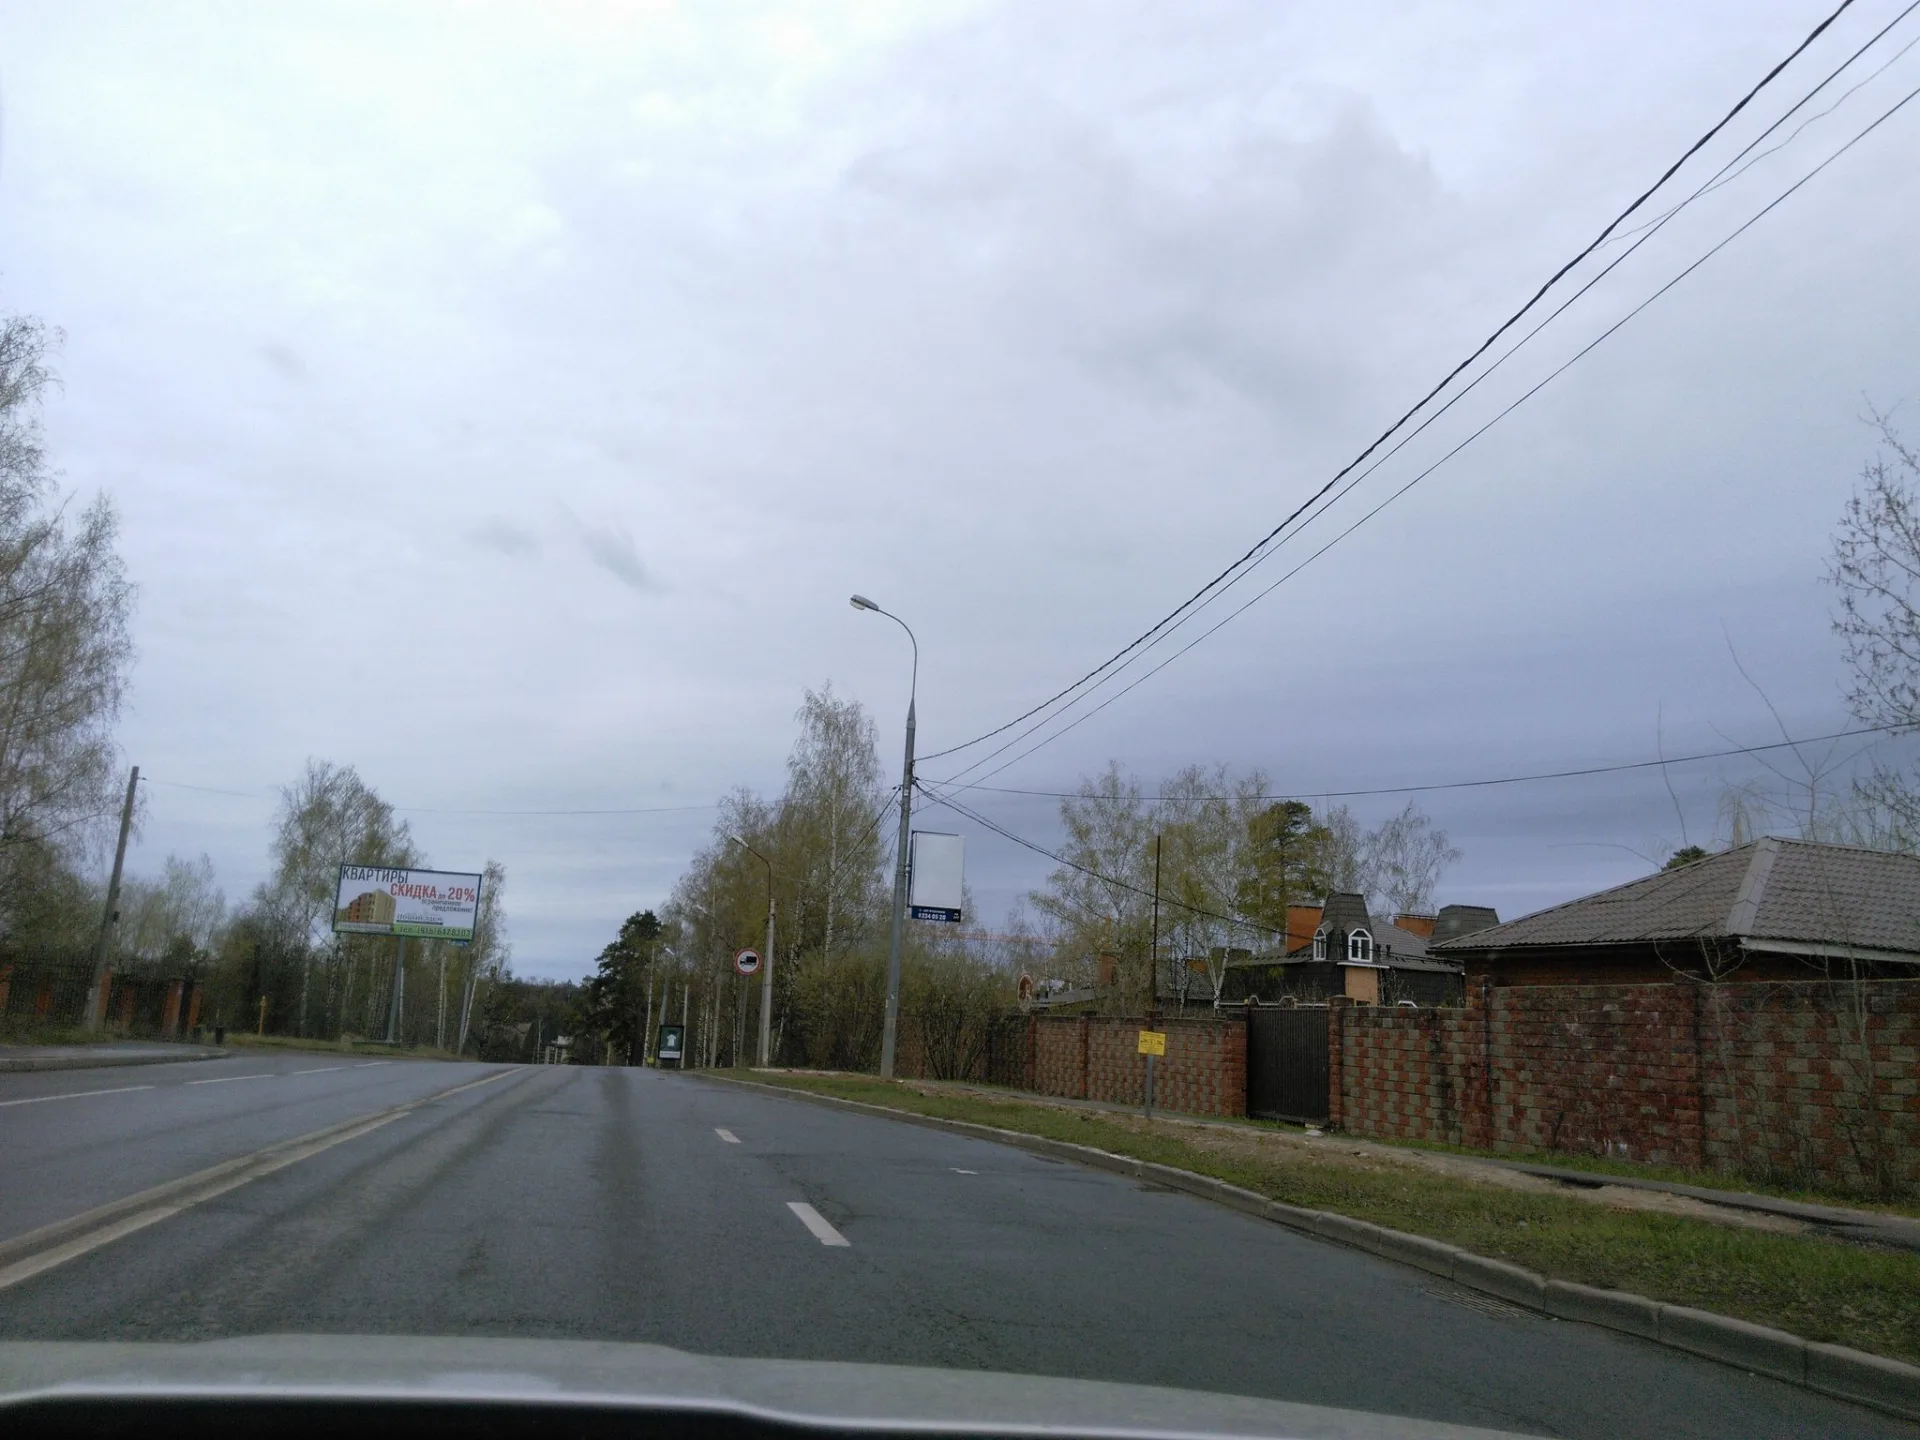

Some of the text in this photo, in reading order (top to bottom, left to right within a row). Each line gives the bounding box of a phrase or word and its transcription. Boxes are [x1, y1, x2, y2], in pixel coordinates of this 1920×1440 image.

[342, 867, 409, 884] КВАРТИРЫ
[390, 883, 437, 900] СКИДКА
[447, 887, 475, 902] 20%
